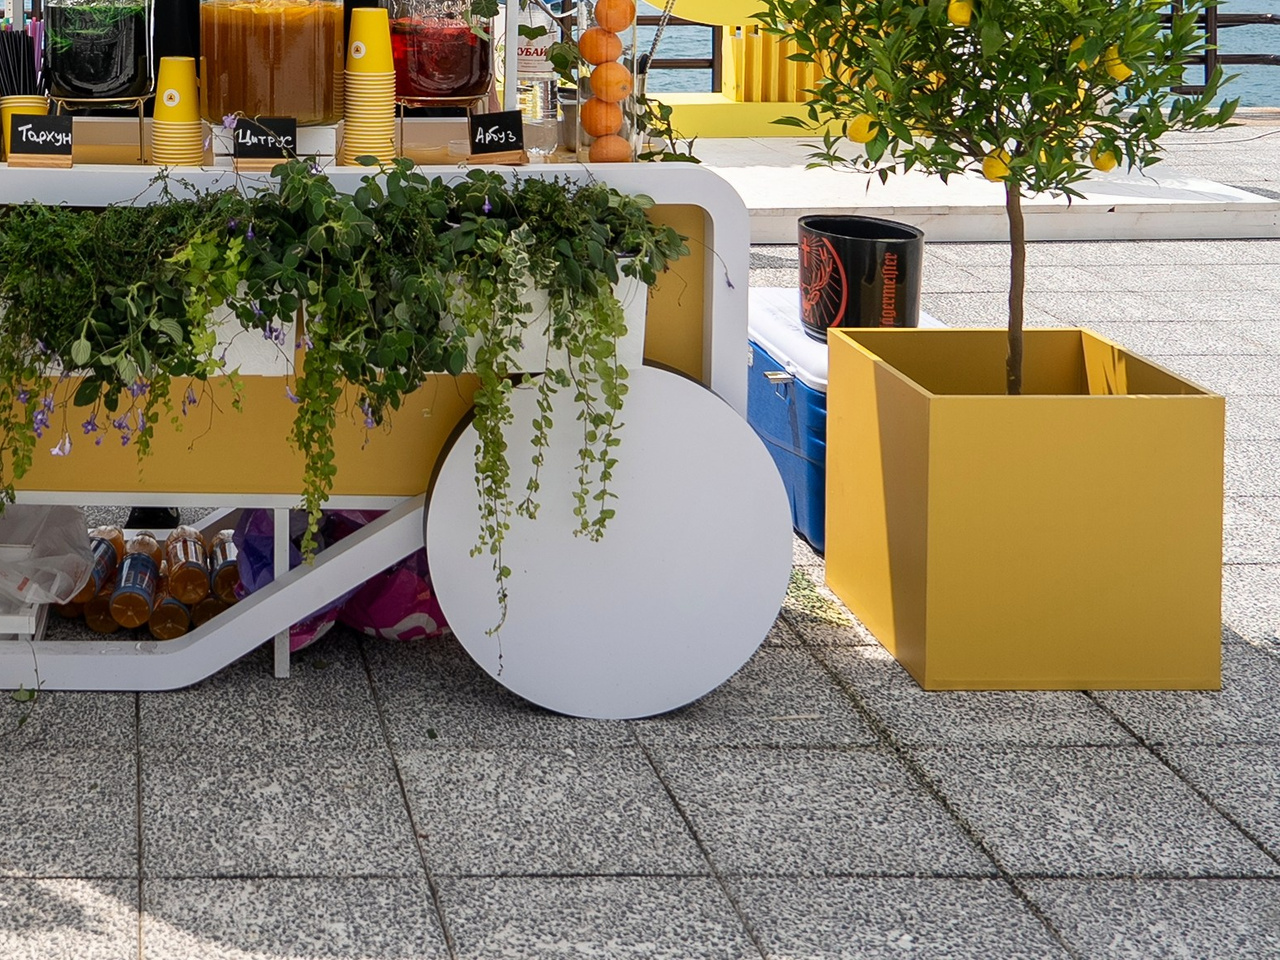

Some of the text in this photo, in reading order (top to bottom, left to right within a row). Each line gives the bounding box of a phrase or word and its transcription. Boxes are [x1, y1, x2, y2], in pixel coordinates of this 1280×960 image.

[516, 45, 549, 57] УБАЙ
[17, 123, 72, 147] Тархун
[235, 128, 294, 148] Цитрус
[475, 125, 517, 145] Арбуз
